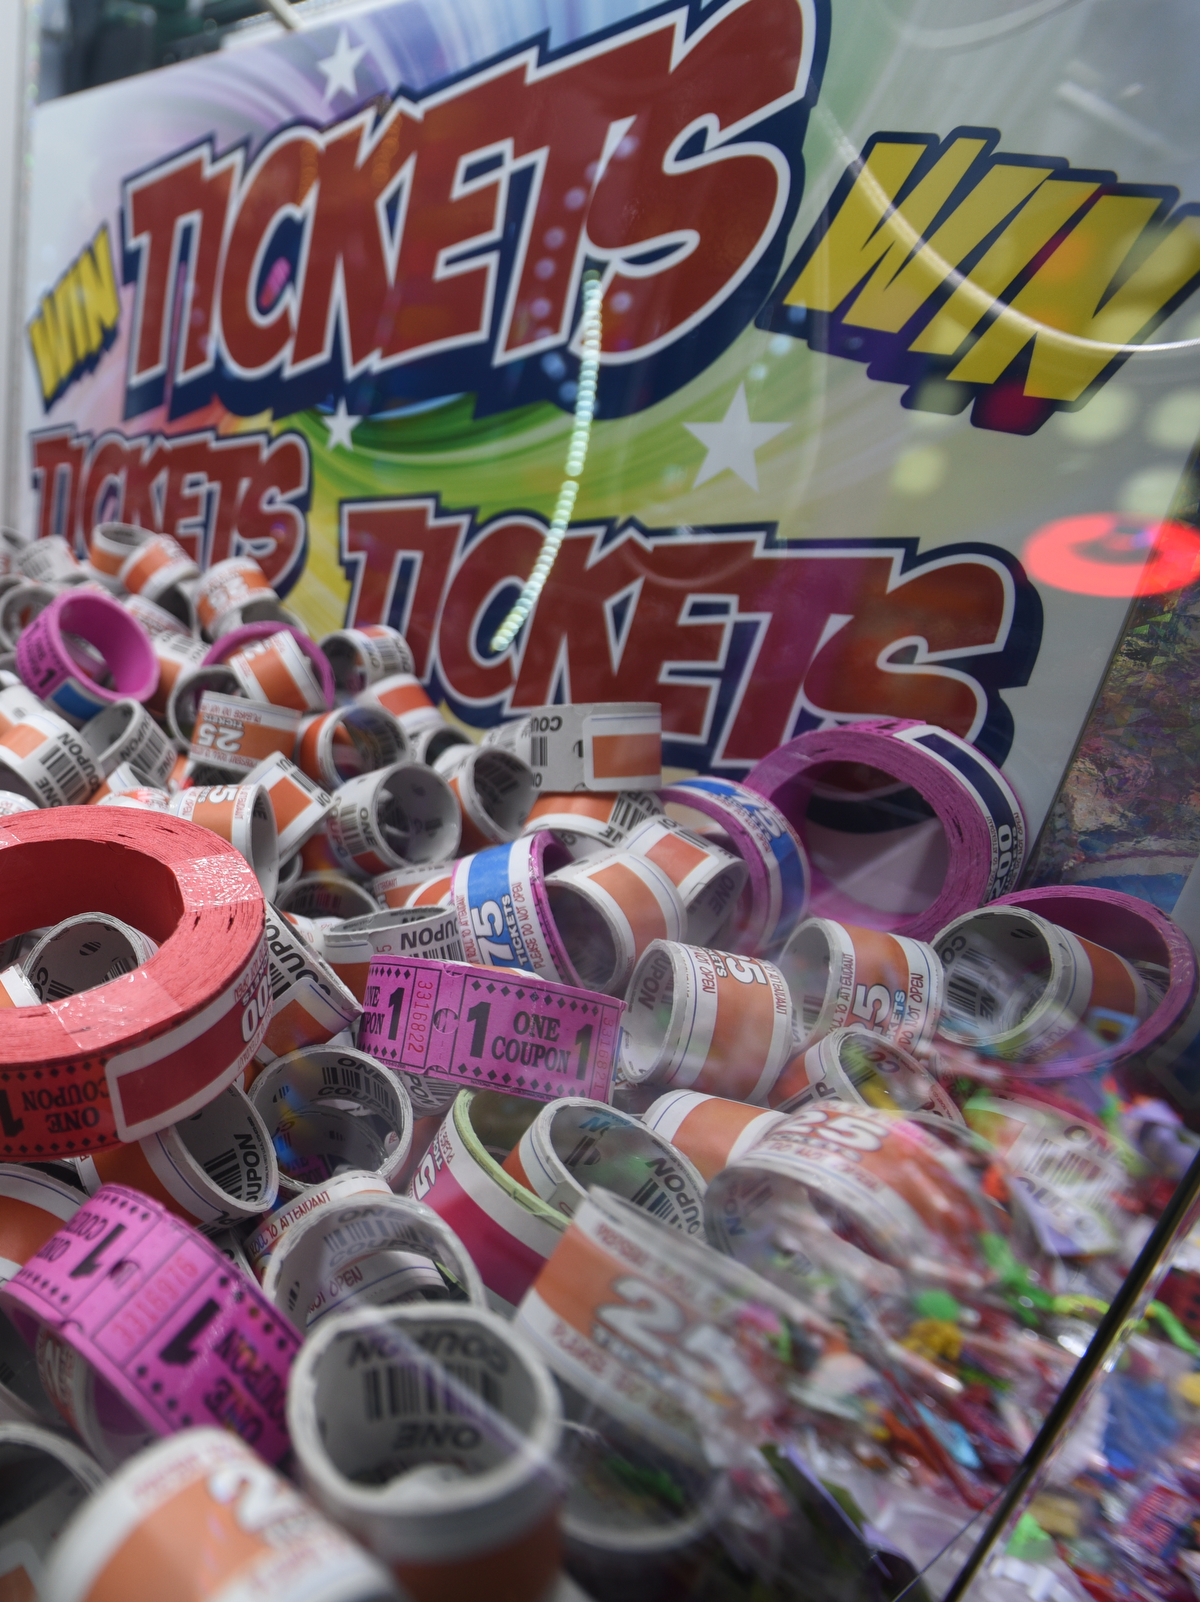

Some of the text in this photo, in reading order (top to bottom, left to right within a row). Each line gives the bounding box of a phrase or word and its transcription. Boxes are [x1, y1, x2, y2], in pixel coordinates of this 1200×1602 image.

[126, 0, 812, 387] TICKETS
[783, 134, 1200, 402] WIN
[29, 226, 121, 405] WIN
[32, 425, 310, 592] TICKETS
[343, 497, 1016, 770] TICKETS
[197, 722, 246, 753] 25
[359, 806, 379, 847] ONE
[511, 881, 527, 904] OPEN
[471, 900, 516, 967] 75
[502, 895, 531, 969] TICKETS
[525, 936, 546, 970] PLEASE
[834, 952, 854, 1002] ATTENDANT
[908, 973, 925, 1004] OPEN
[387, 986, 406, 1042] 1
[407, 979, 435, 1055] 3316822
[467, 1000, 492, 1060] 1
[512, 1009, 562, 1044] ONE
[905, 1004, 922, 1028] NOT
[337, 1057, 389, 1086] ONE
[490, 1034, 572, 1075] COUPON
[573, 1022, 595, 1082] 1
[44, 1105, 101, 1134] ONE
[267, 1223, 279, 1239] TO
[279, 1190, 331, 1230] ATTENDANT
[68, 1222, 128, 1281] 1
[329, 1265, 363, 1298] OPEN
[158, 1297, 222, 1366] 1
[392, 1421, 483, 1453] ONE
